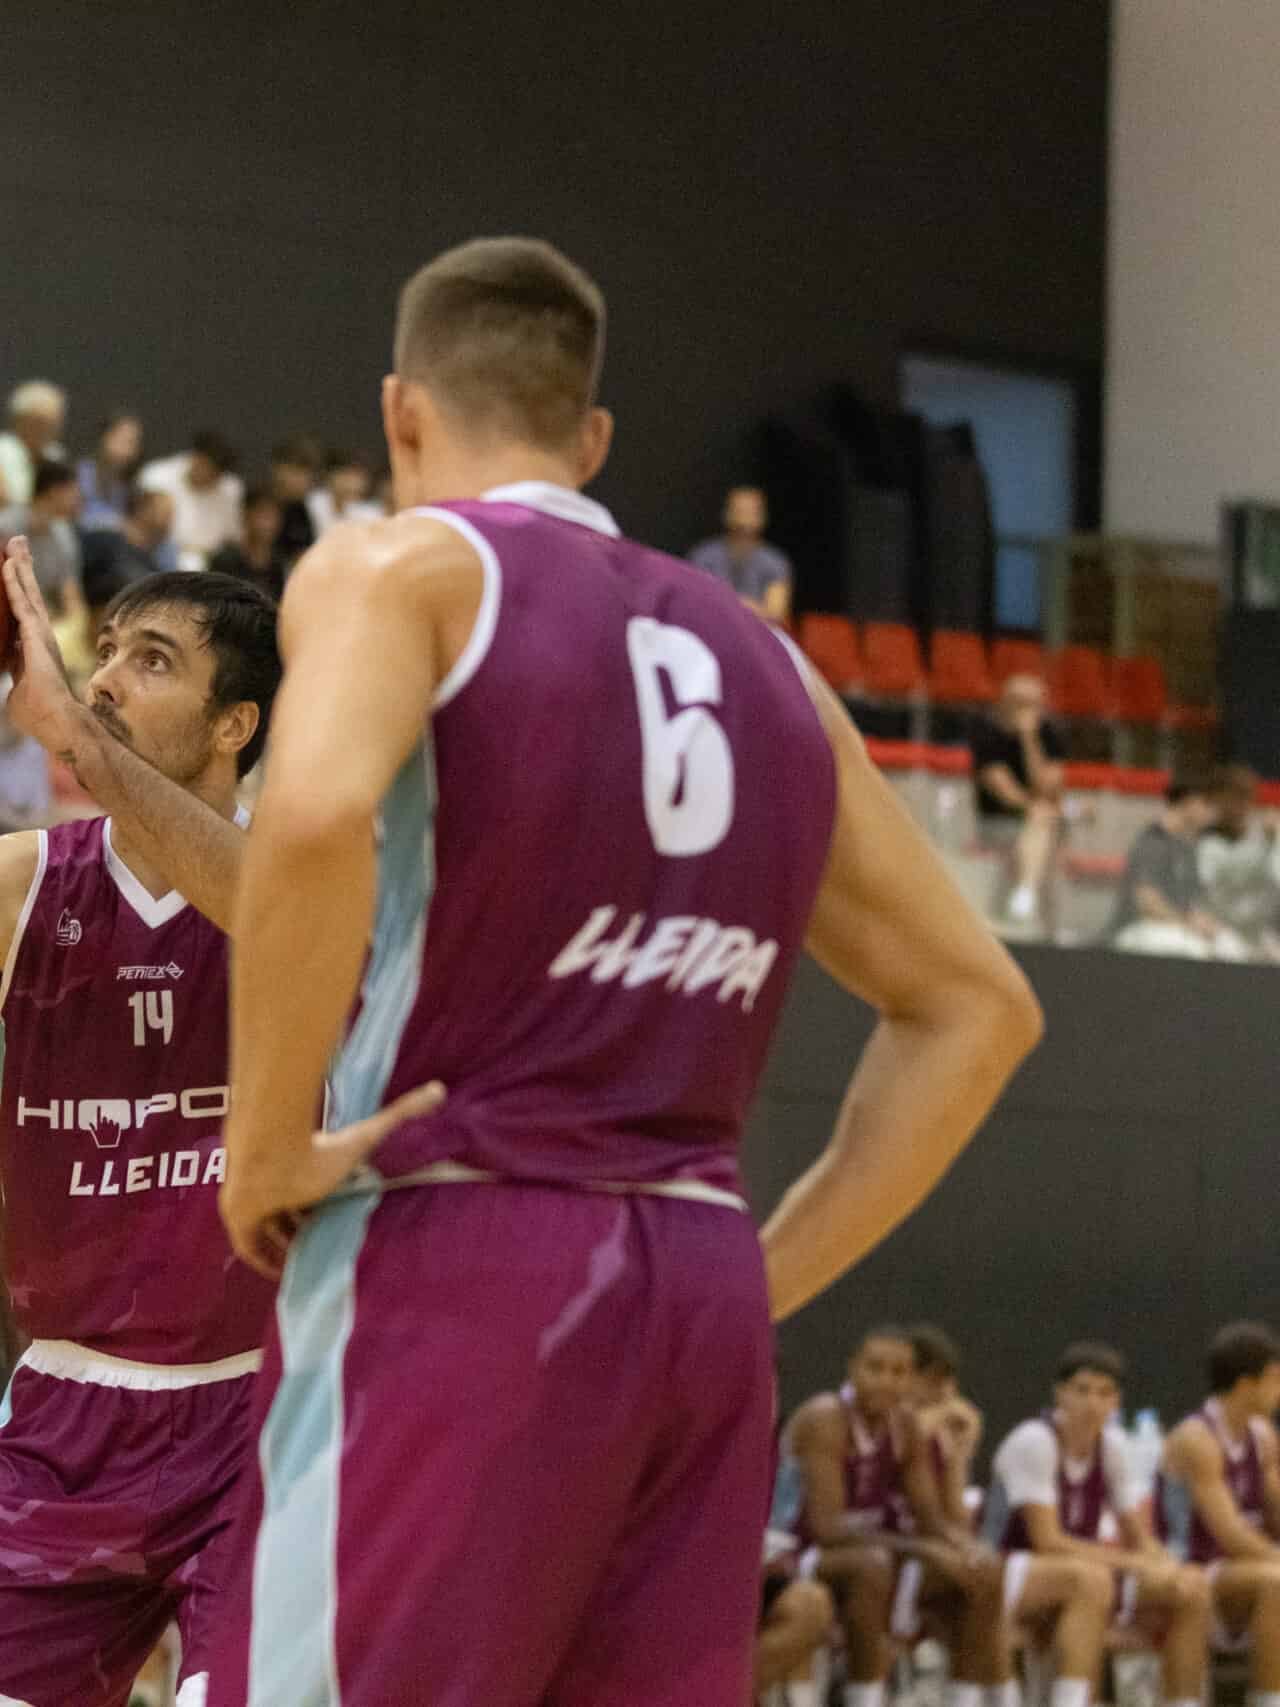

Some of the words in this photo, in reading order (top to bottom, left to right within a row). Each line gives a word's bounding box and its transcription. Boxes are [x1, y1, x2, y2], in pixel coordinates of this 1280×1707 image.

[626, 616, 736, 858] 6
[127, 990, 174, 1046] 14
[17, 1085, 231, 1148] HIOPO
[69, 1148, 228, 1197] LLEIDA
